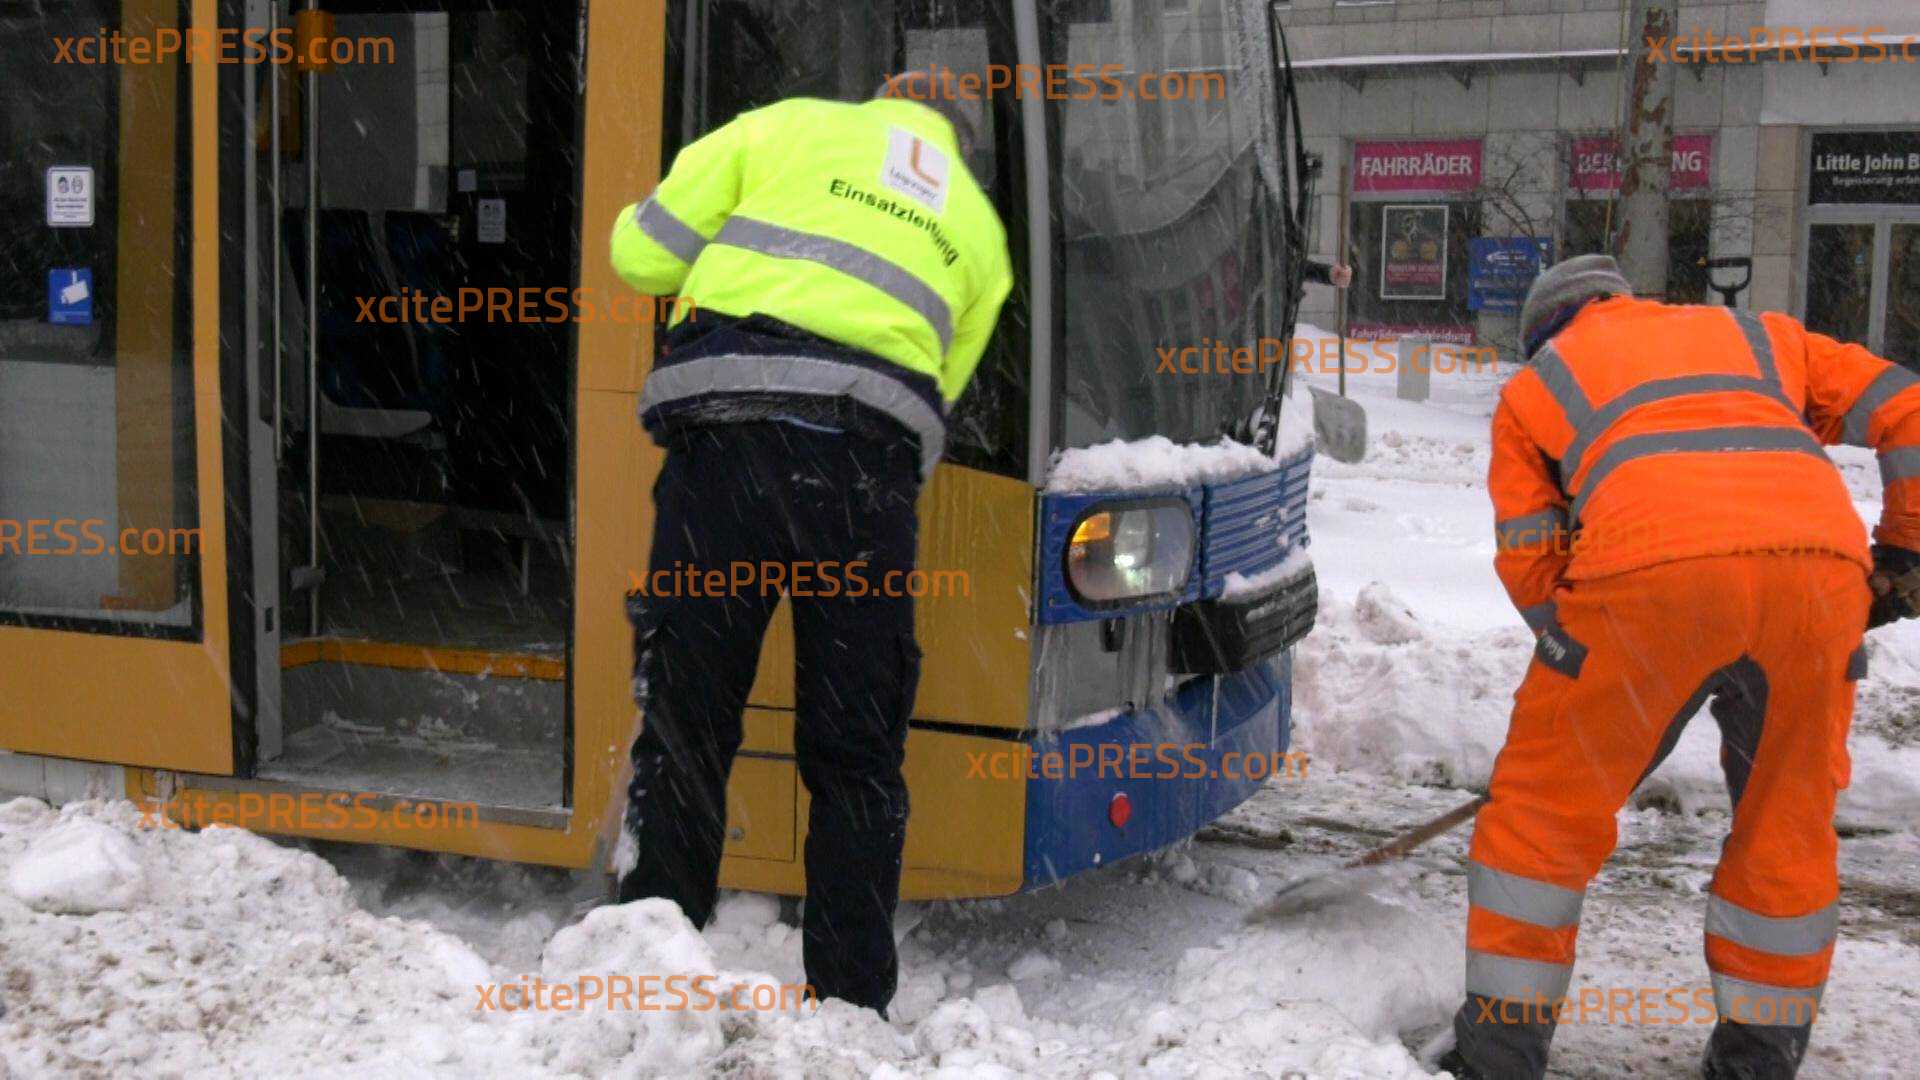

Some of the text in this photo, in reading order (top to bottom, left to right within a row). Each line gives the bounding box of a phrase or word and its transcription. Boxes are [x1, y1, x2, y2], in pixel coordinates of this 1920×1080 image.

[1361, 153, 1473, 176] FAHRRÄDER
[1816, 153, 1861, 171] Little
[1863, 153, 1905, 175] John
[830, 178, 959, 267] Einsatzleitung
